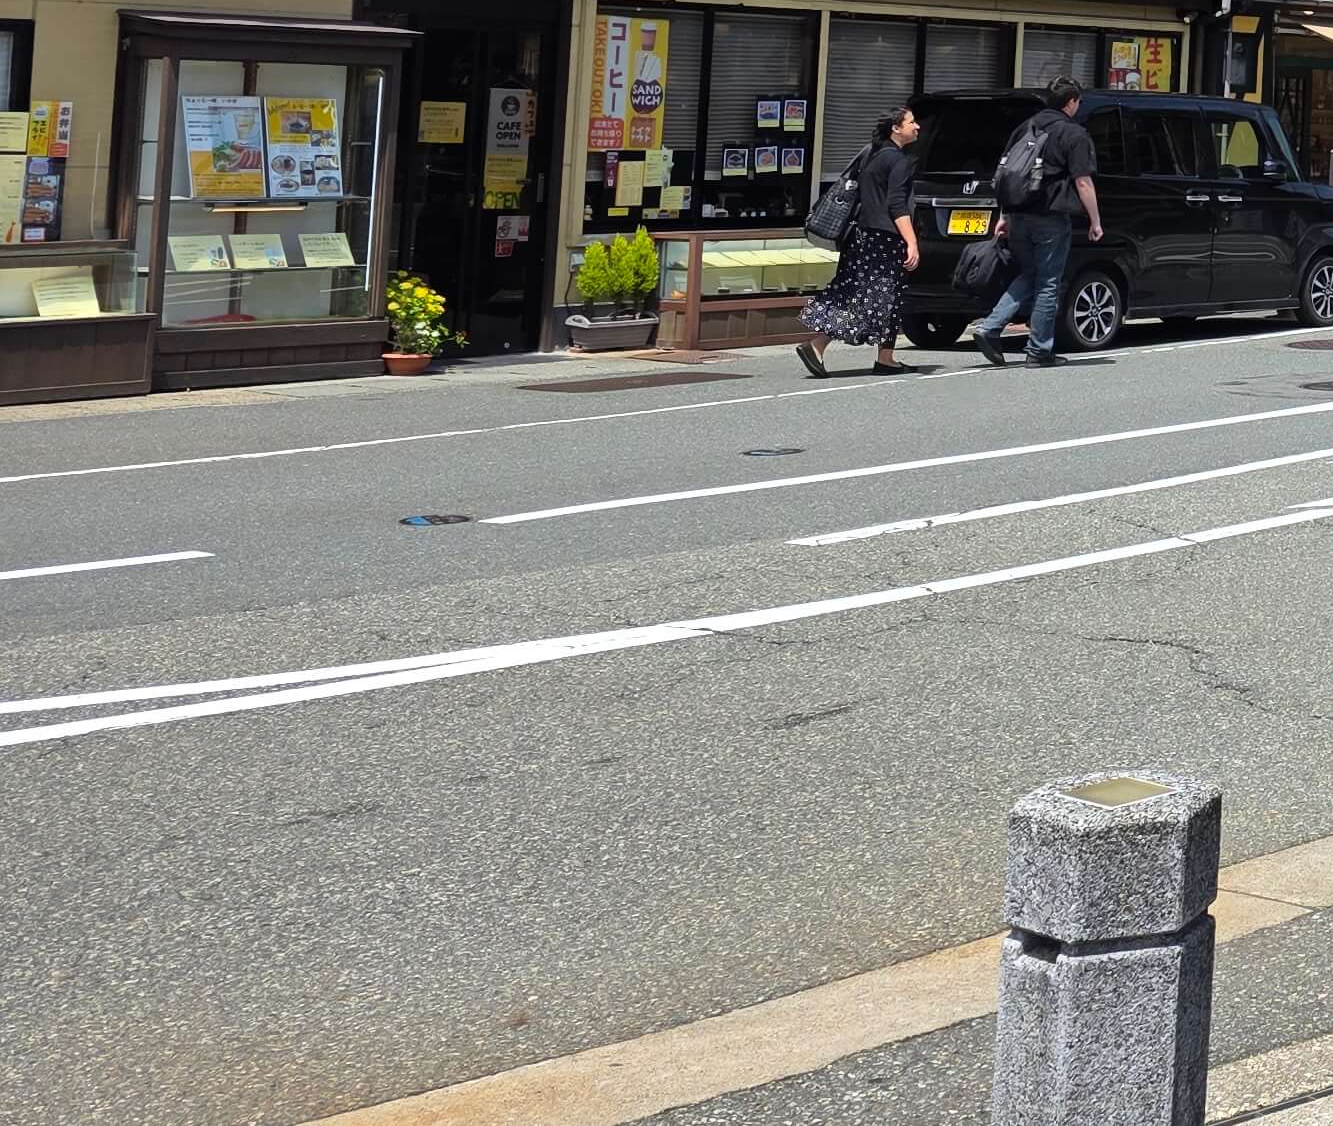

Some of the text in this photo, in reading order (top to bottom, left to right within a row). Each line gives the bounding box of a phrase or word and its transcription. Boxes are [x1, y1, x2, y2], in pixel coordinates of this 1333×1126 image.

[609, 22, 627, 113] コーヒー
[632, 84, 661, 95] SAND
[631, 94, 660, 106] WICH
[58, 106, 71, 141] お弁当
[496, 121, 522, 131] CAFE
[495, 131, 521, 140] OPEN
